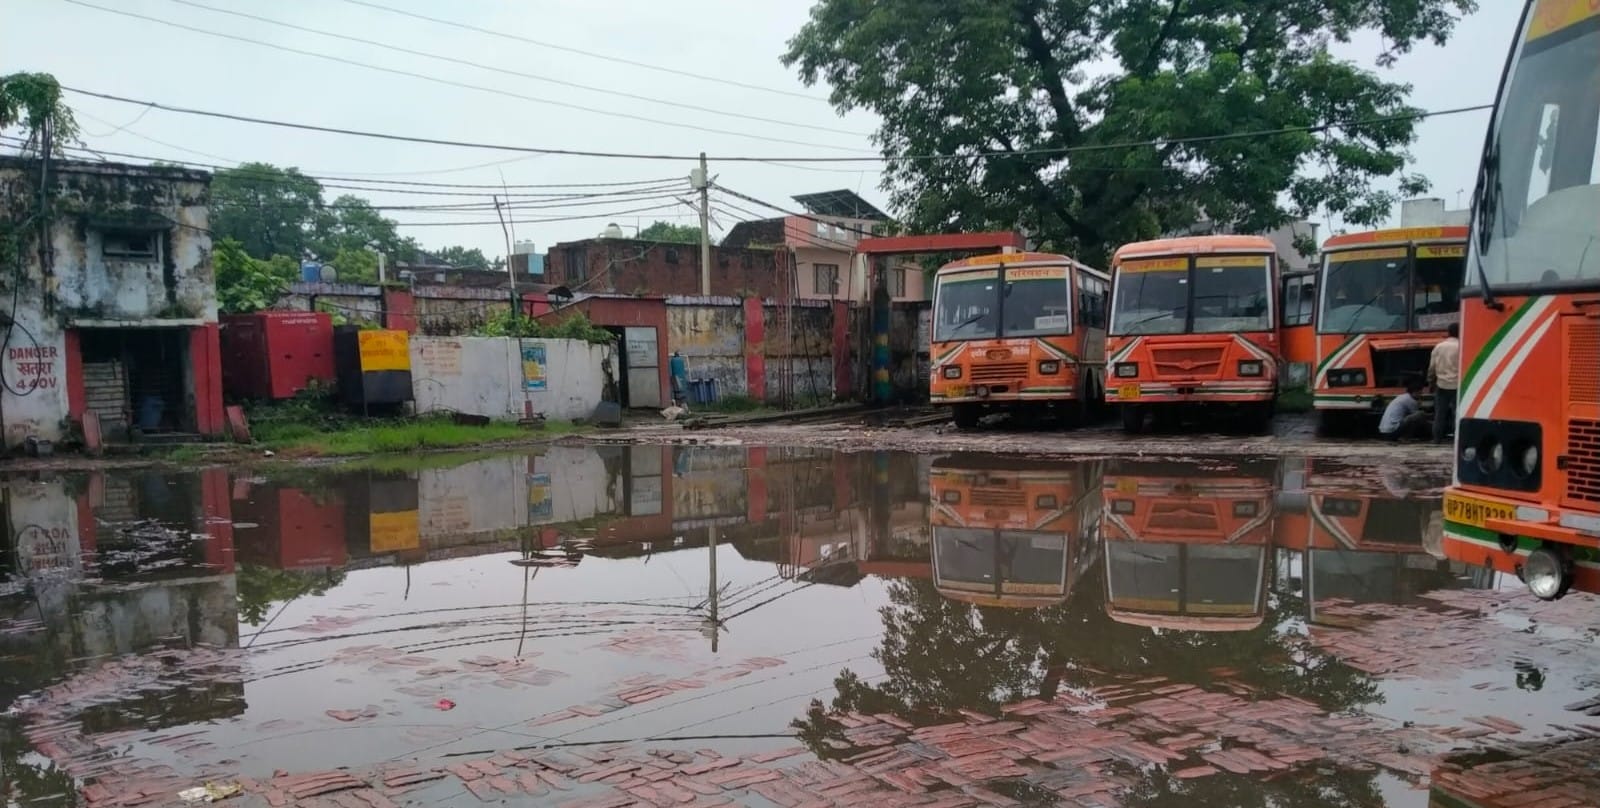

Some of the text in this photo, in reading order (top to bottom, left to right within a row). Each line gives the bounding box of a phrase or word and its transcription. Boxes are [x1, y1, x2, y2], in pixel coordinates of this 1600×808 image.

[9, 346, 58, 360] DANGER
[16, 362, 54, 376] खतरा
[16, 377, 57, 390] 440V
